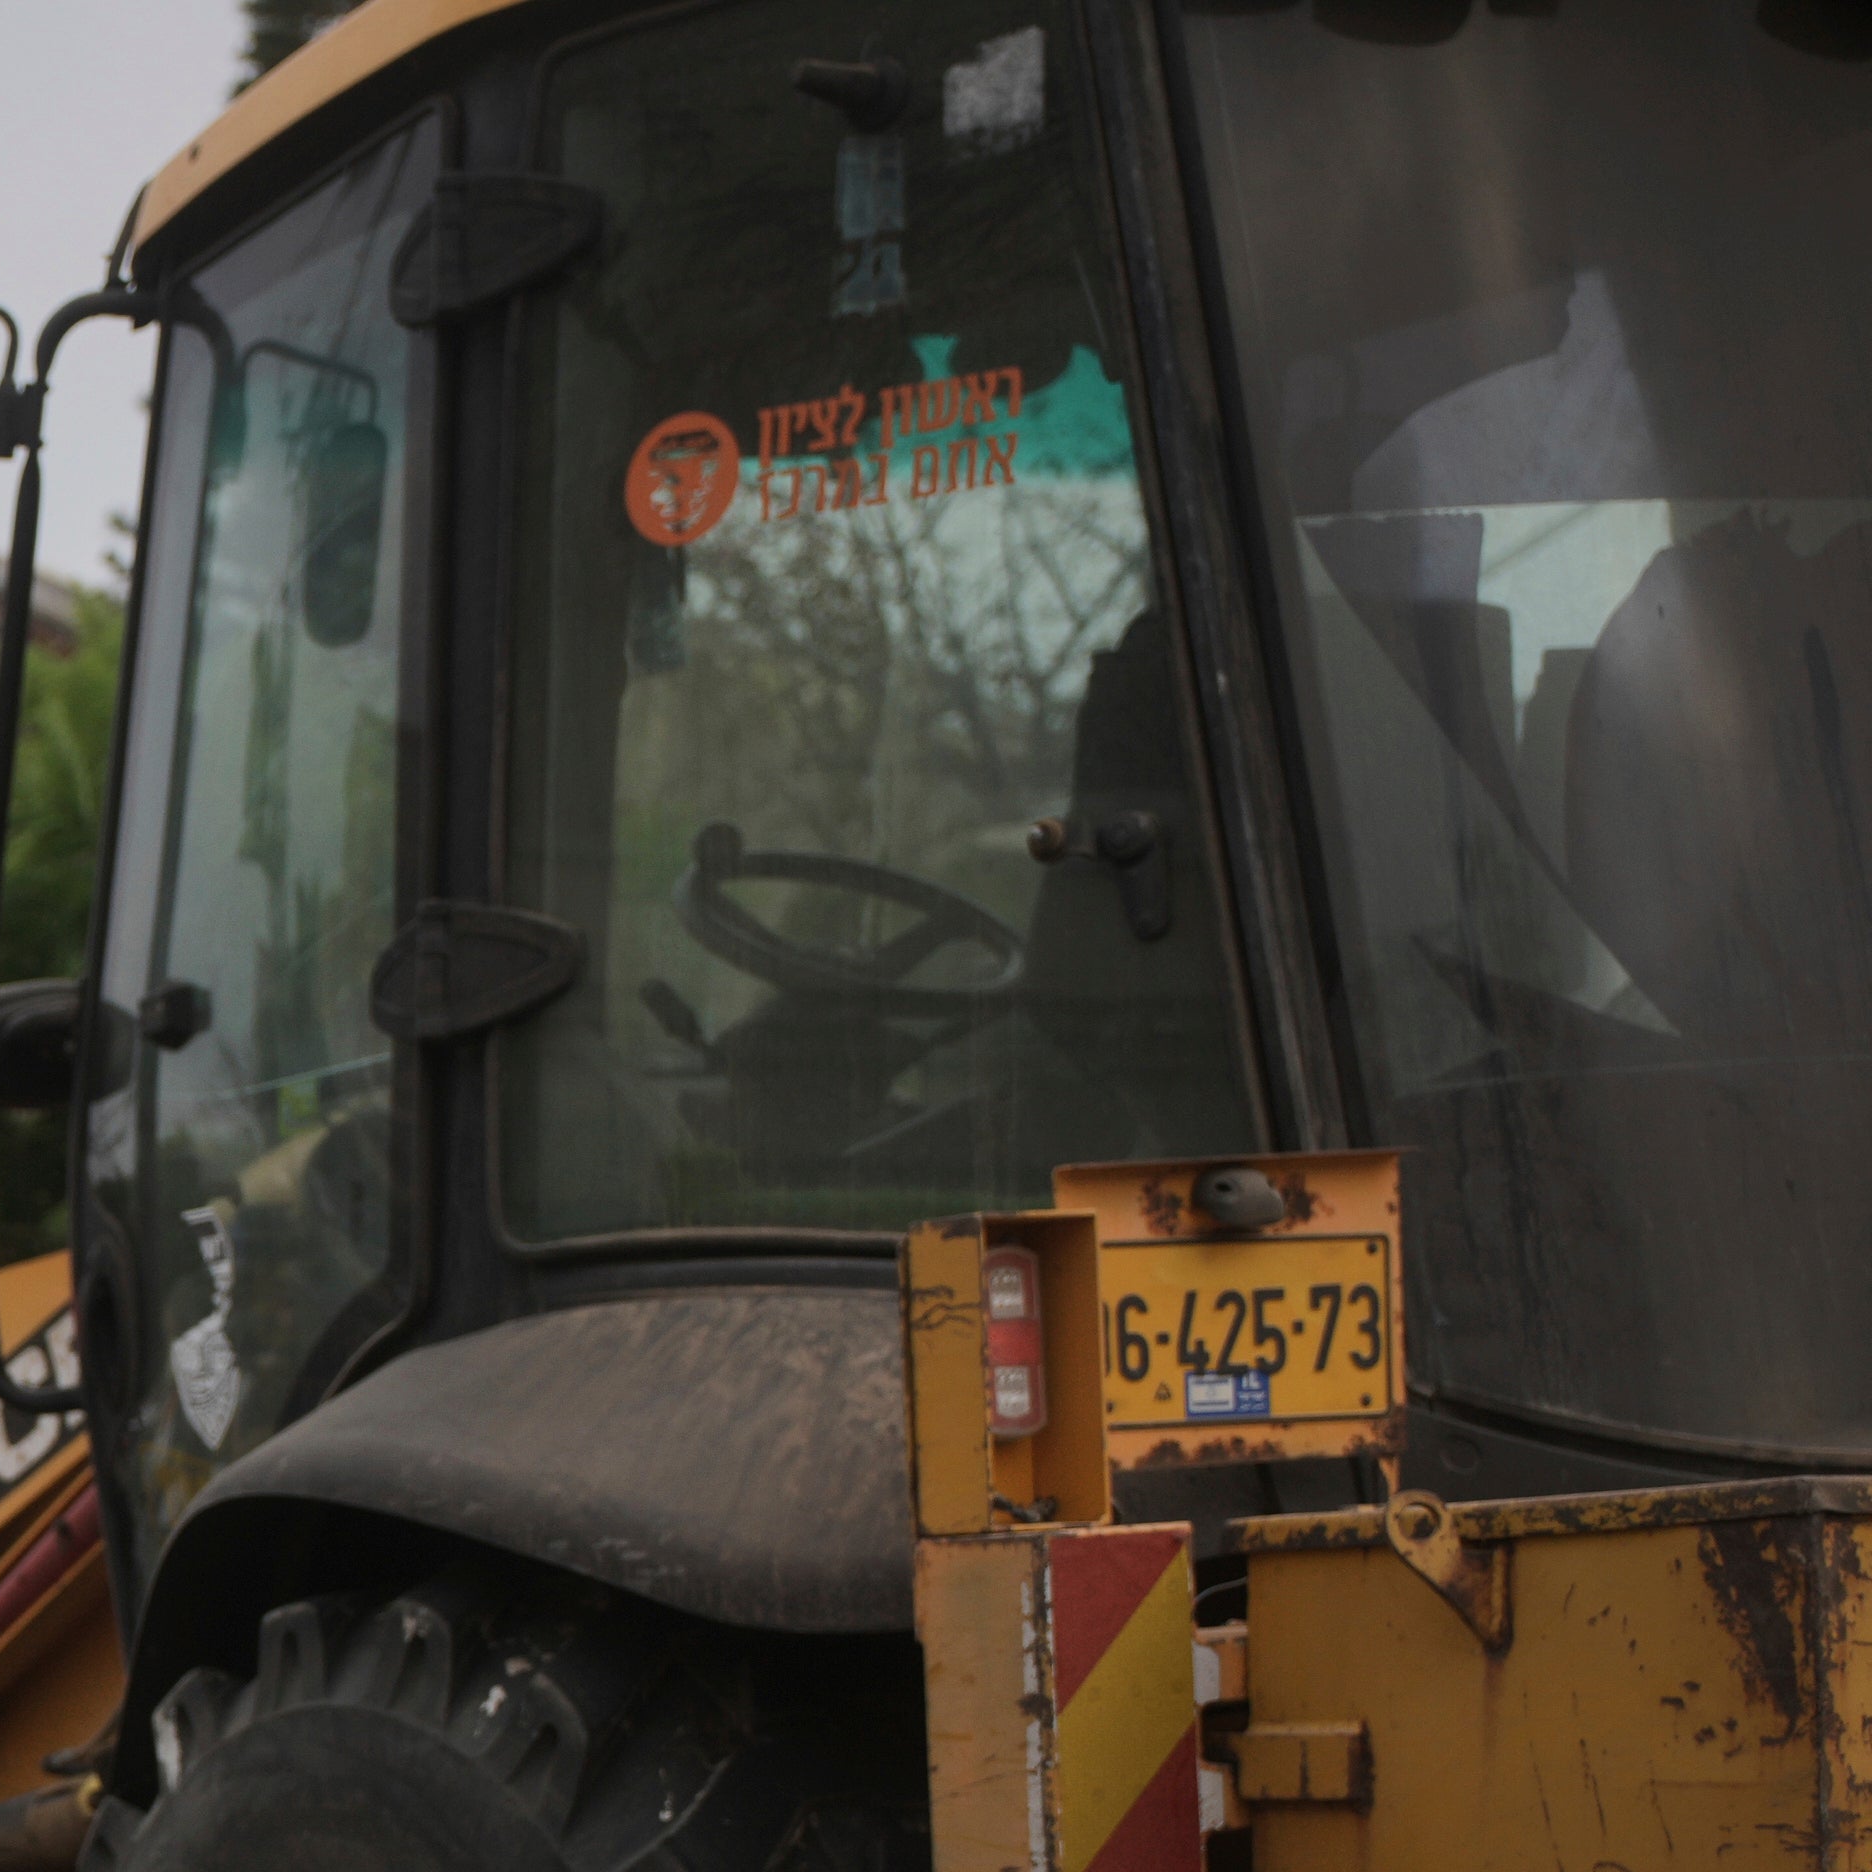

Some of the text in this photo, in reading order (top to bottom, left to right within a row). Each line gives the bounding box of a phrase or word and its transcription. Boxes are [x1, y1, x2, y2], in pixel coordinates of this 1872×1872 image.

[758, 366, 1023, 467] ראשון לציון
[758, 432, 1021, 522] אתם במרכז
[1102, 1284, 1381, 1380] 6-425-73
